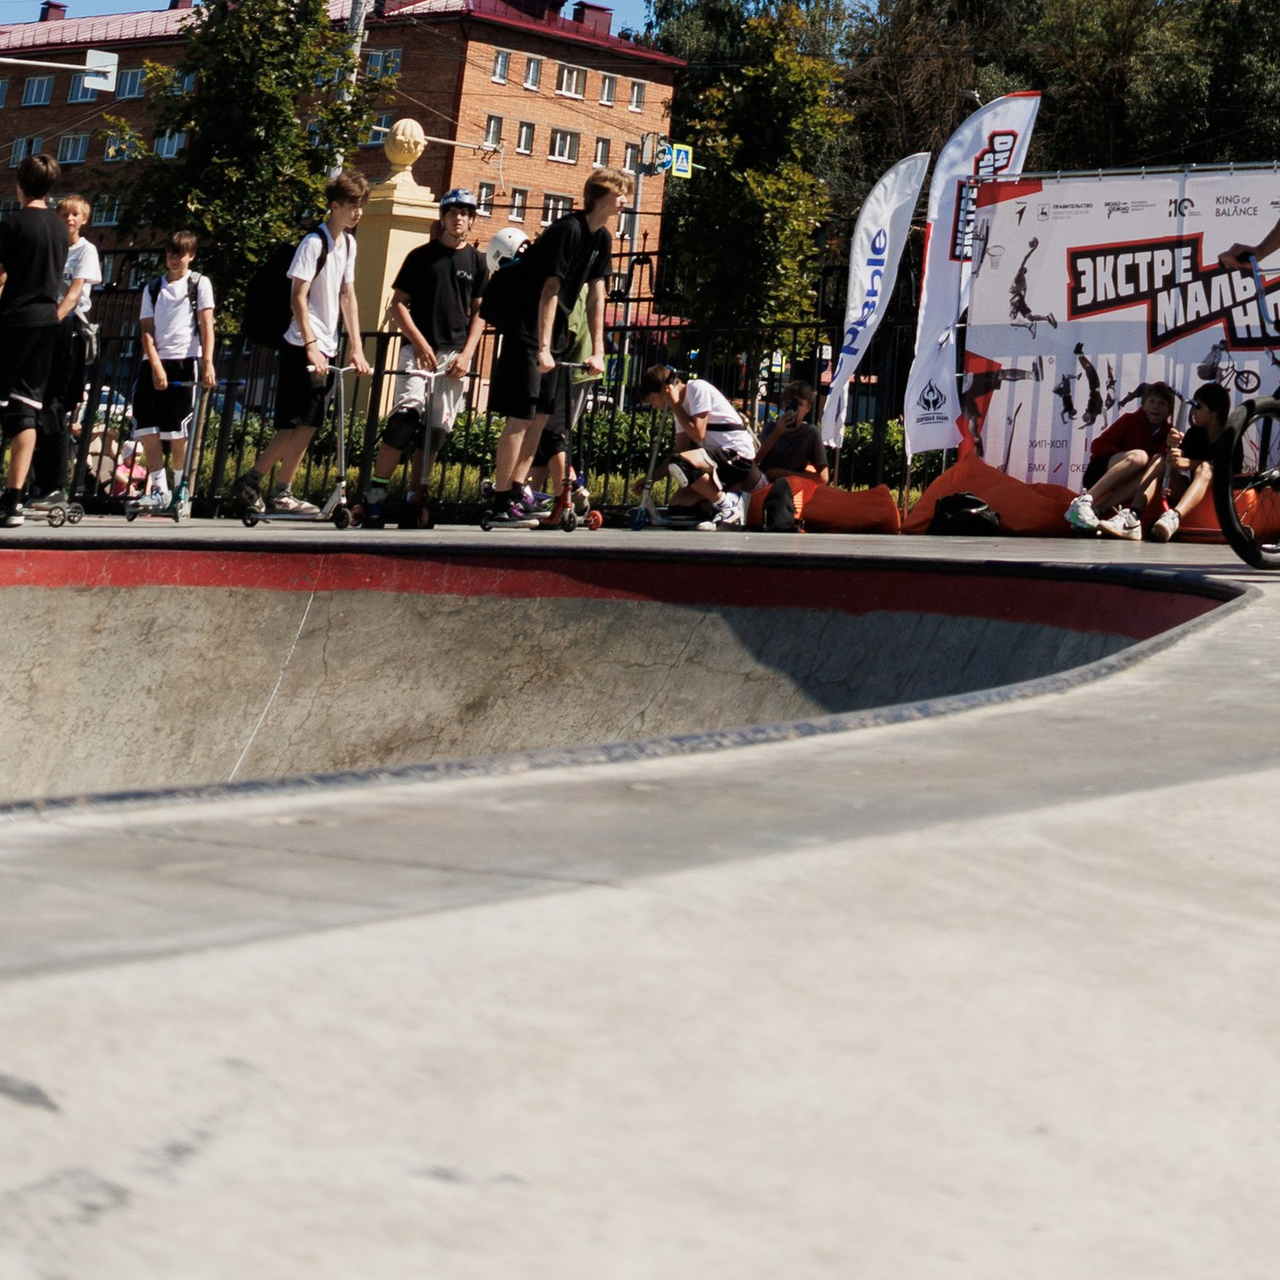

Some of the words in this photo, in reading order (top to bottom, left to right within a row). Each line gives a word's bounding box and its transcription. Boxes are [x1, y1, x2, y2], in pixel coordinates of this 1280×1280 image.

[1215, 195, 1241, 205] KING
[1076, 246, 1193, 307] ЭКСТРЕ
[1156, 269, 1257, 336] МАЛЬ
[1029, 439, 1068, 449] ХИП-ХОП
[1028, 462, 1046, 472] БМХ
